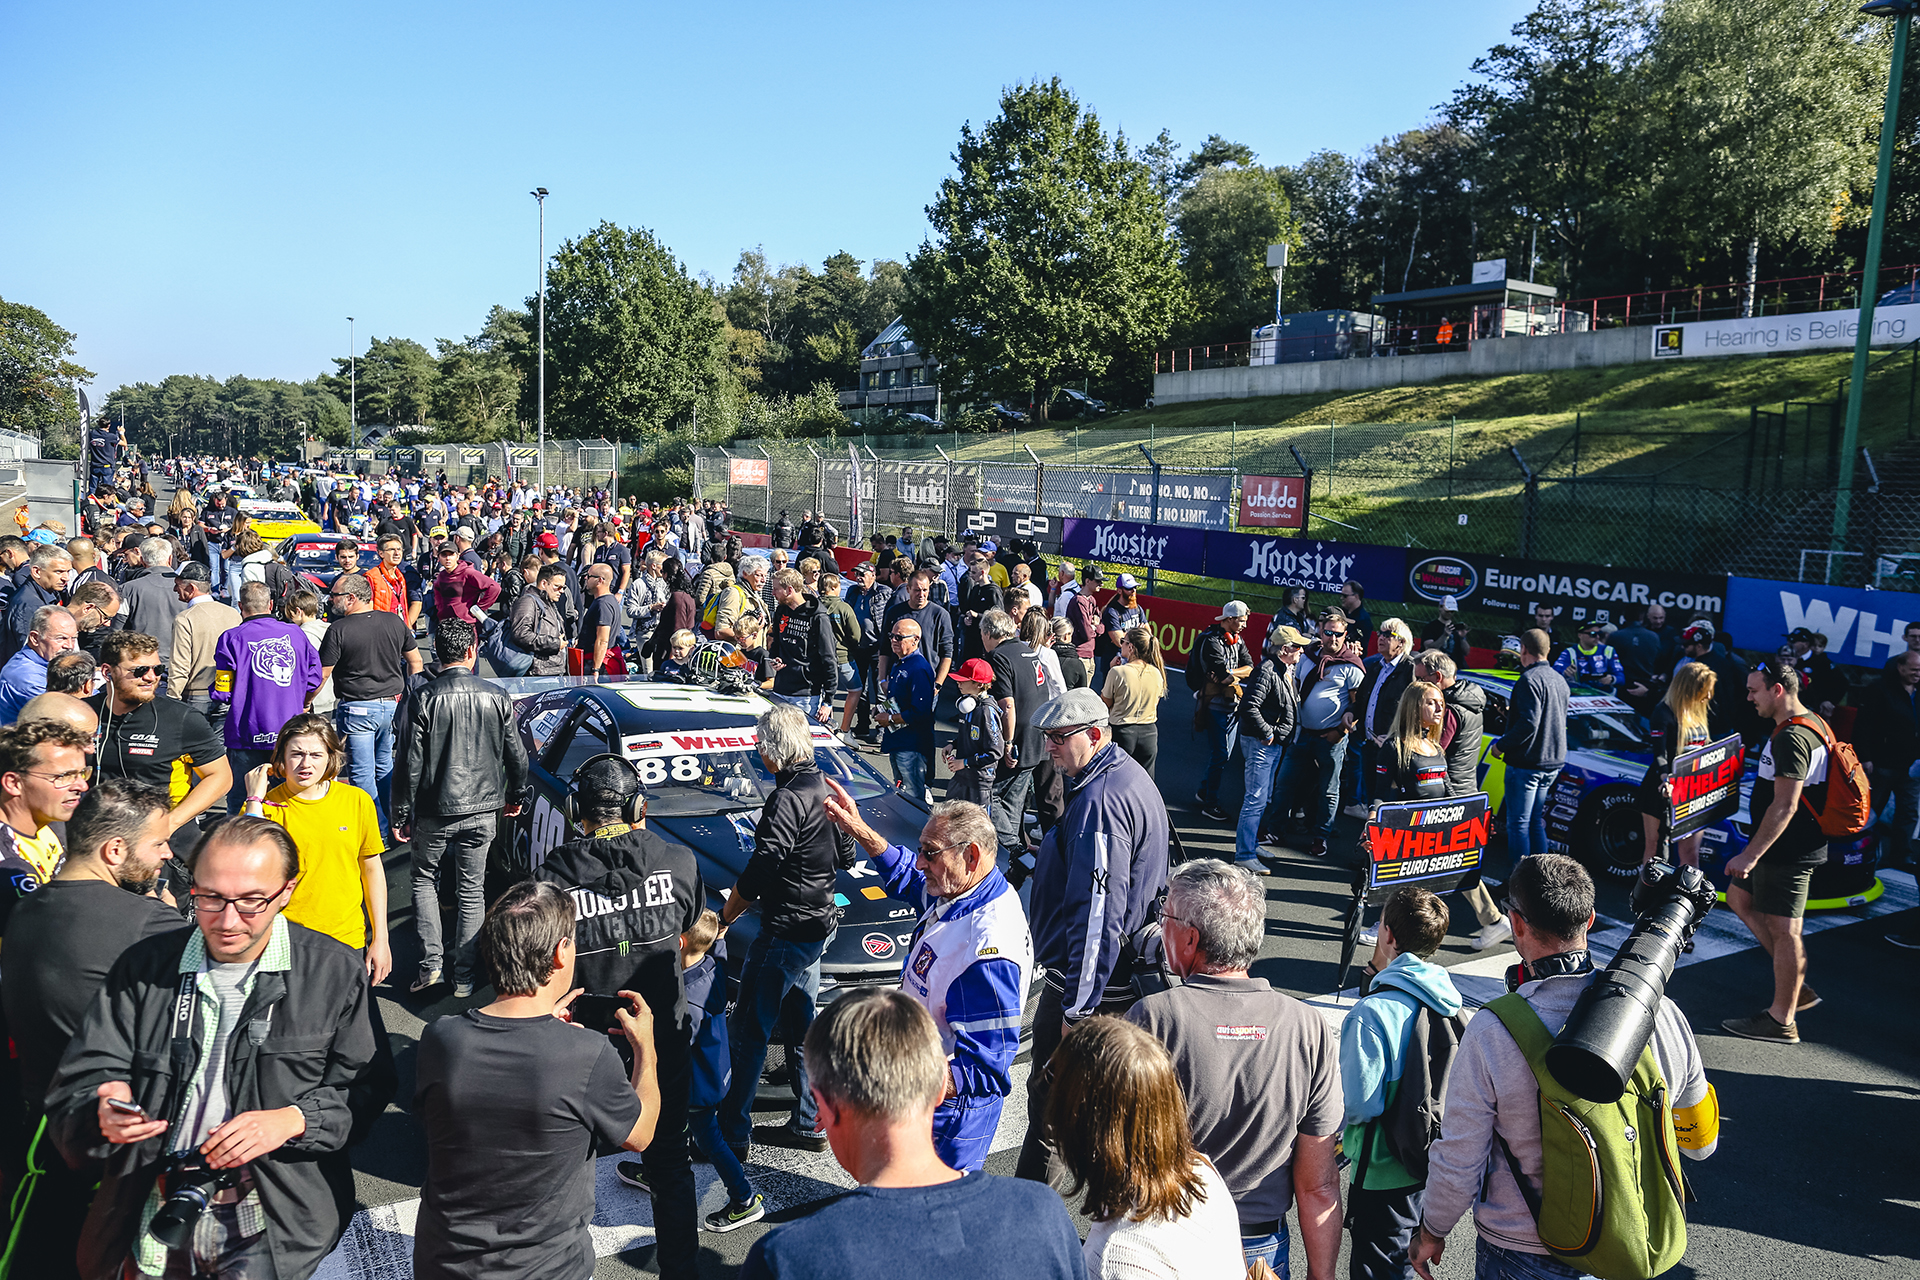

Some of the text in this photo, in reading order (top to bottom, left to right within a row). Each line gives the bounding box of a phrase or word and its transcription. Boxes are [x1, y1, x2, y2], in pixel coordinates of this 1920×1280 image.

[1705, 318, 1906, 348] Hearing is Belieing
[1272, 511, 1292, 519] Service
[1089, 524, 1169, 559] Hoosier
[1110, 554, 1161, 568] RACING TIRE
[1243, 539, 1356, 583] Hoosier
[1273, 576, 1343, 593] RACING TIRE
[1421, 572, 1464, 587] WHELEN
[1485, 567, 1722, 613] EuroNASCAR.com
[1482, 598, 1503, 608] Follow
[636, 755, 703, 786] 88
[1700, 747, 1726, 769] NASCAR
[1670, 748, 1745, 805] WHELEN
[1424, 805, 1465, 825] NASCAR
[1369, 810, 1491, 862] WHELEN
[1399, 853, 1464, 877] EURO SERIES
[179, 973, 194, 1021] OLYMPU
